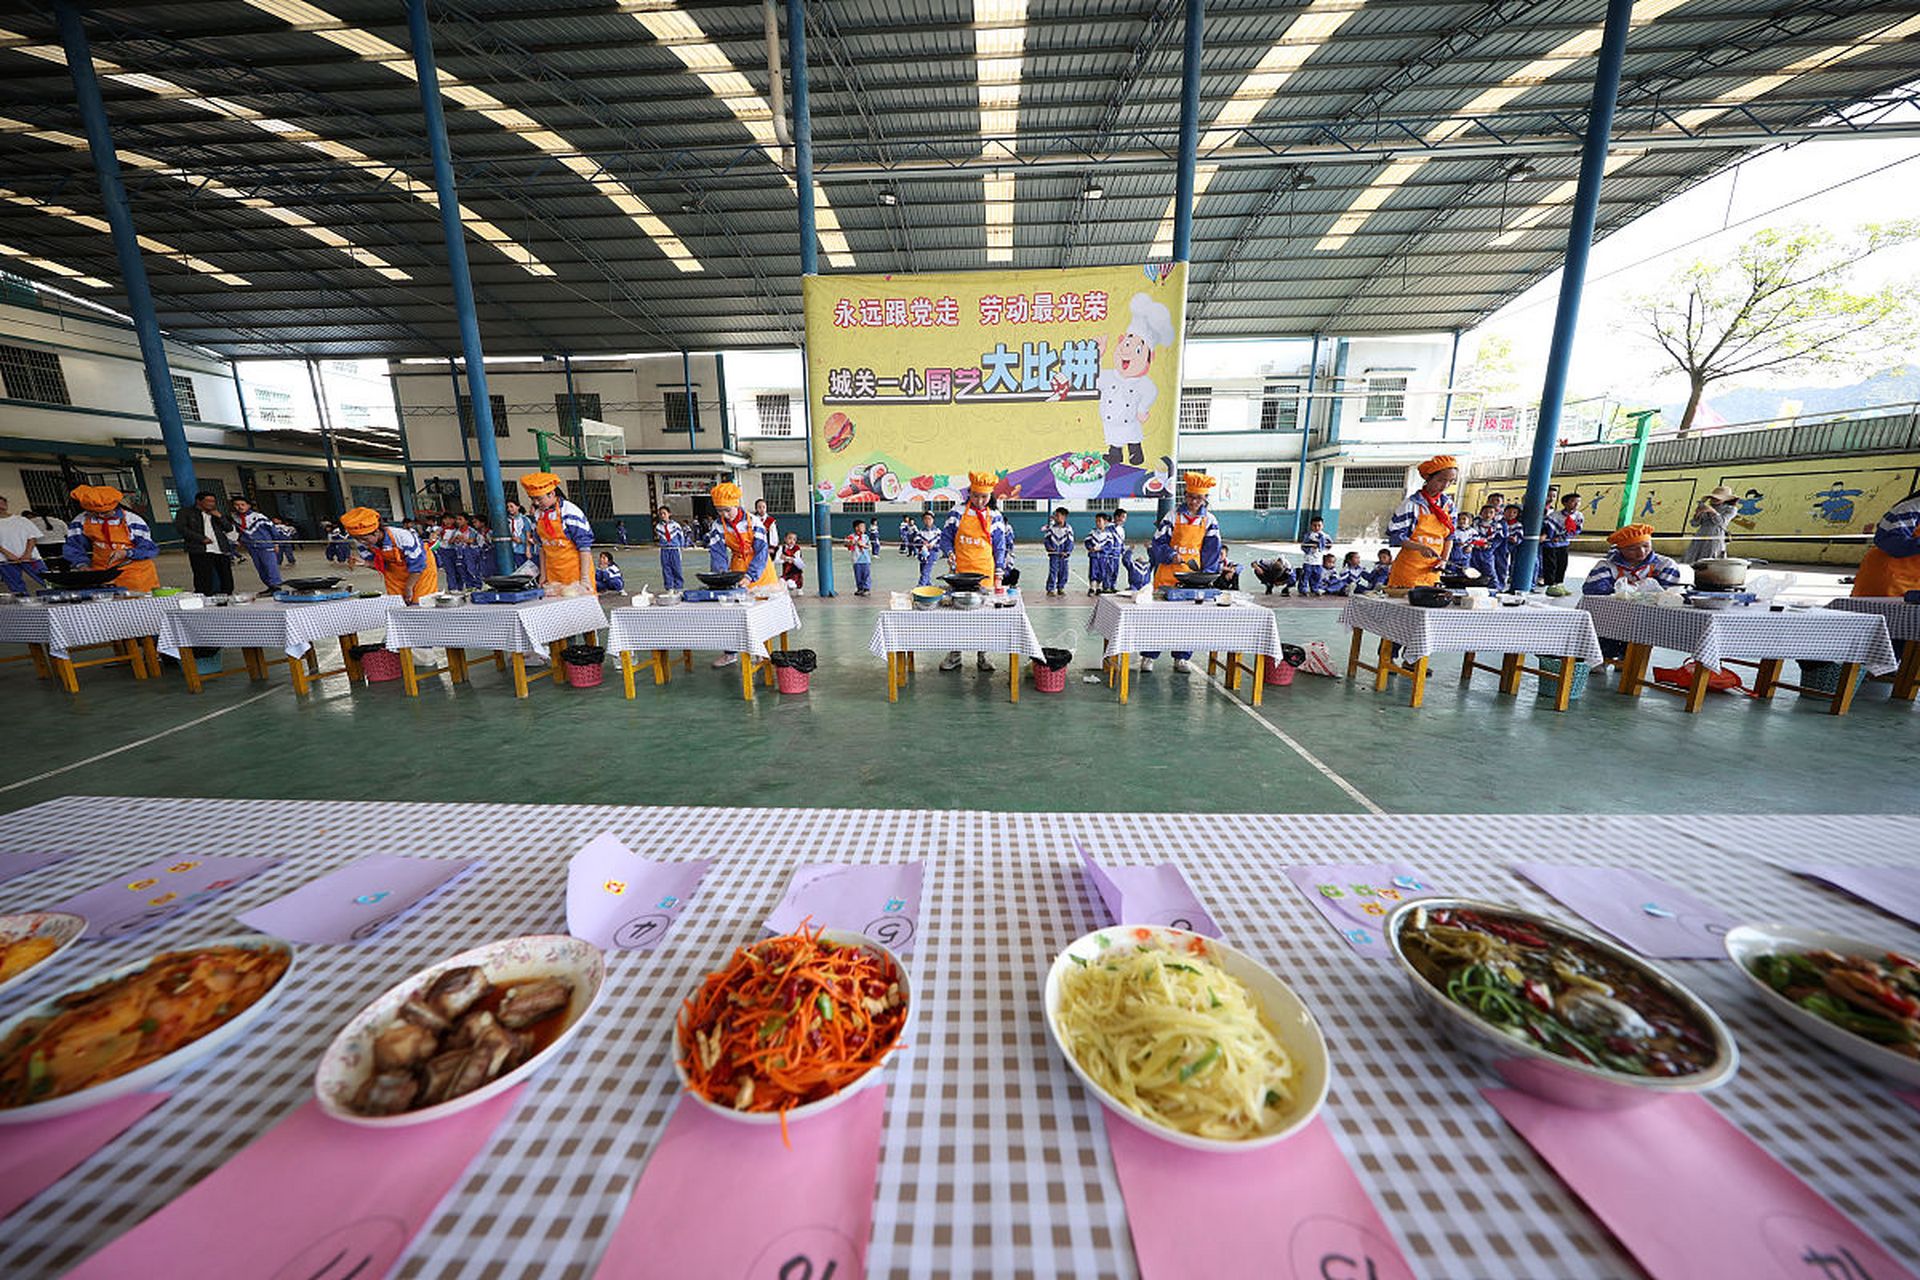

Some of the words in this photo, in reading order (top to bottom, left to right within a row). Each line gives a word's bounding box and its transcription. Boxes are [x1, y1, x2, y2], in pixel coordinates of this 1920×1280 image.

[833, 298, 960, 327] 永远跟党走
[979, 291, 1109, 325] 劳动最光荣
[828, 340, 1101, 402] 城关一小厨艺大比拼
